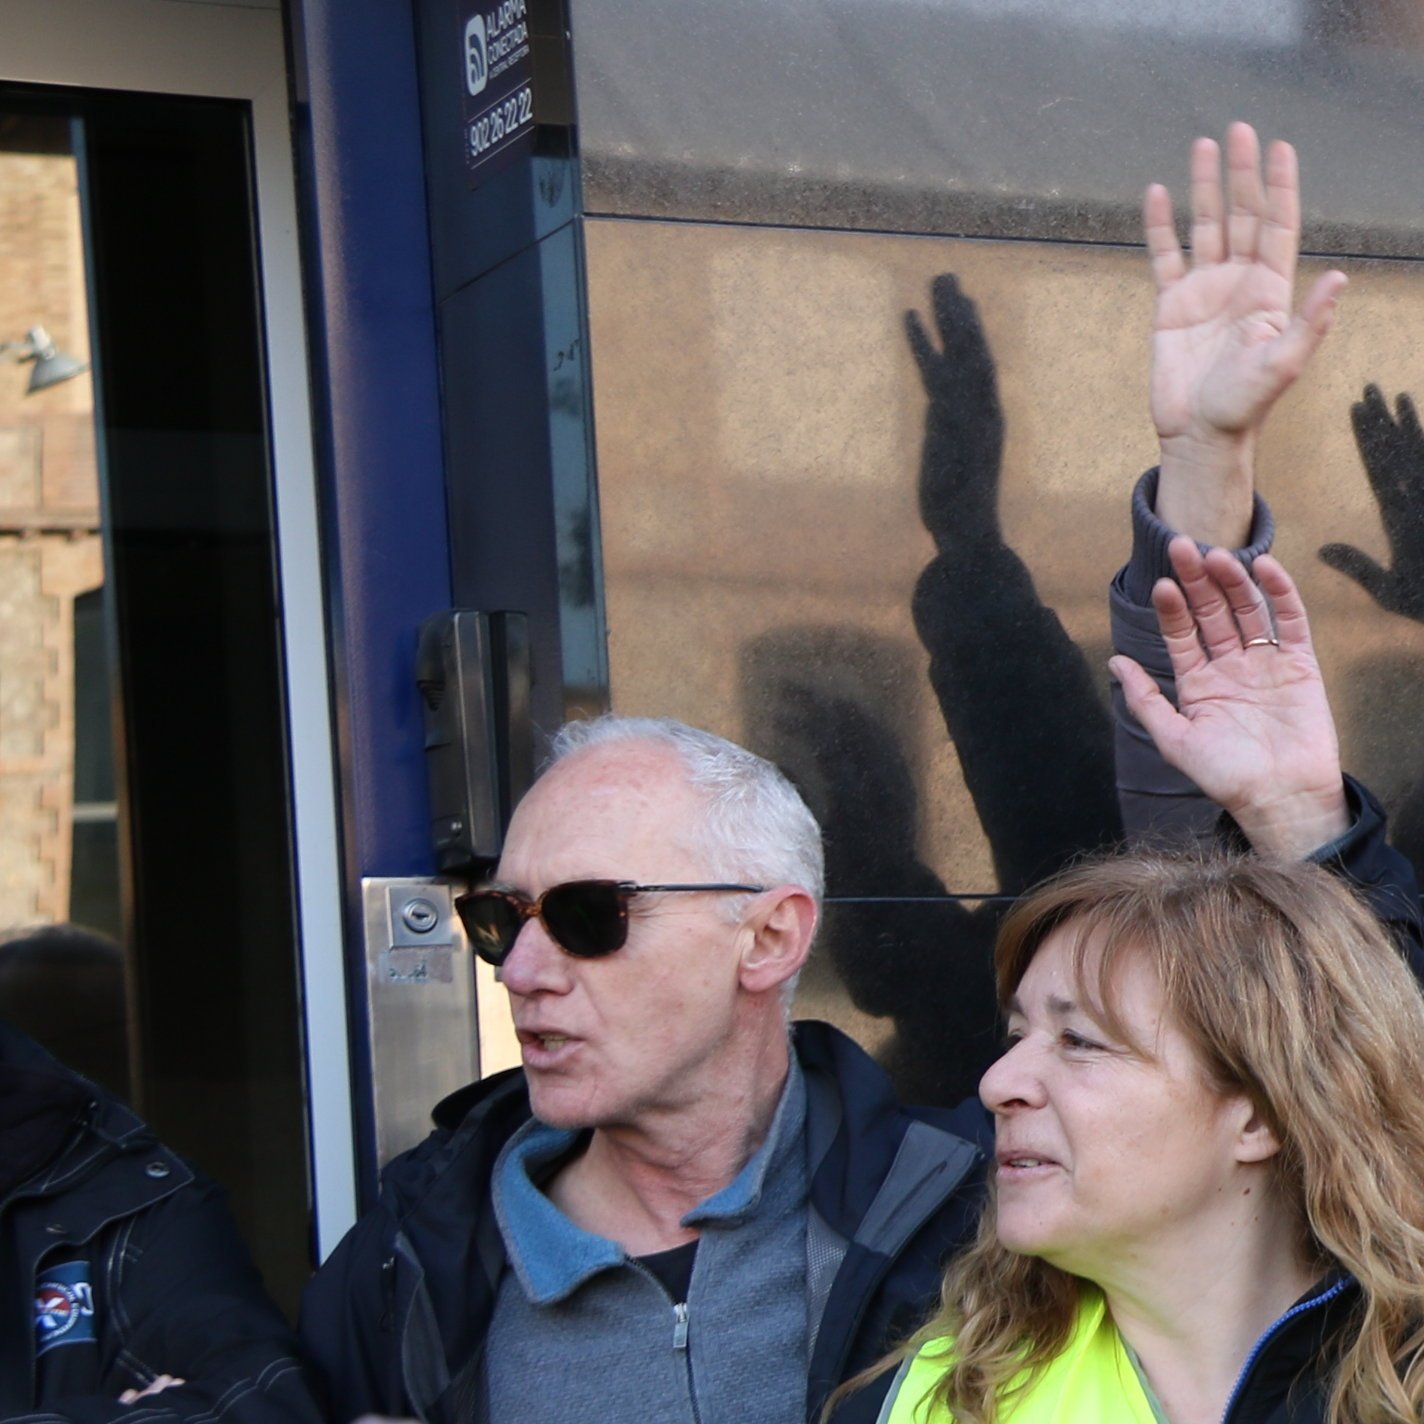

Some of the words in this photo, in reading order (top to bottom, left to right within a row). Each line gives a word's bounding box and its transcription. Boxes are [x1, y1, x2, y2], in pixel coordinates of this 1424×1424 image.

[487, 0, 527, 41] ALARMA
[487, 21, 529, 65] CONECTADA
[471, 117, 490, 156] 902
[490, 108, 504, 144] 26
[504, 98, 519, 134] 22
[519, 88, 533, 124] 22
